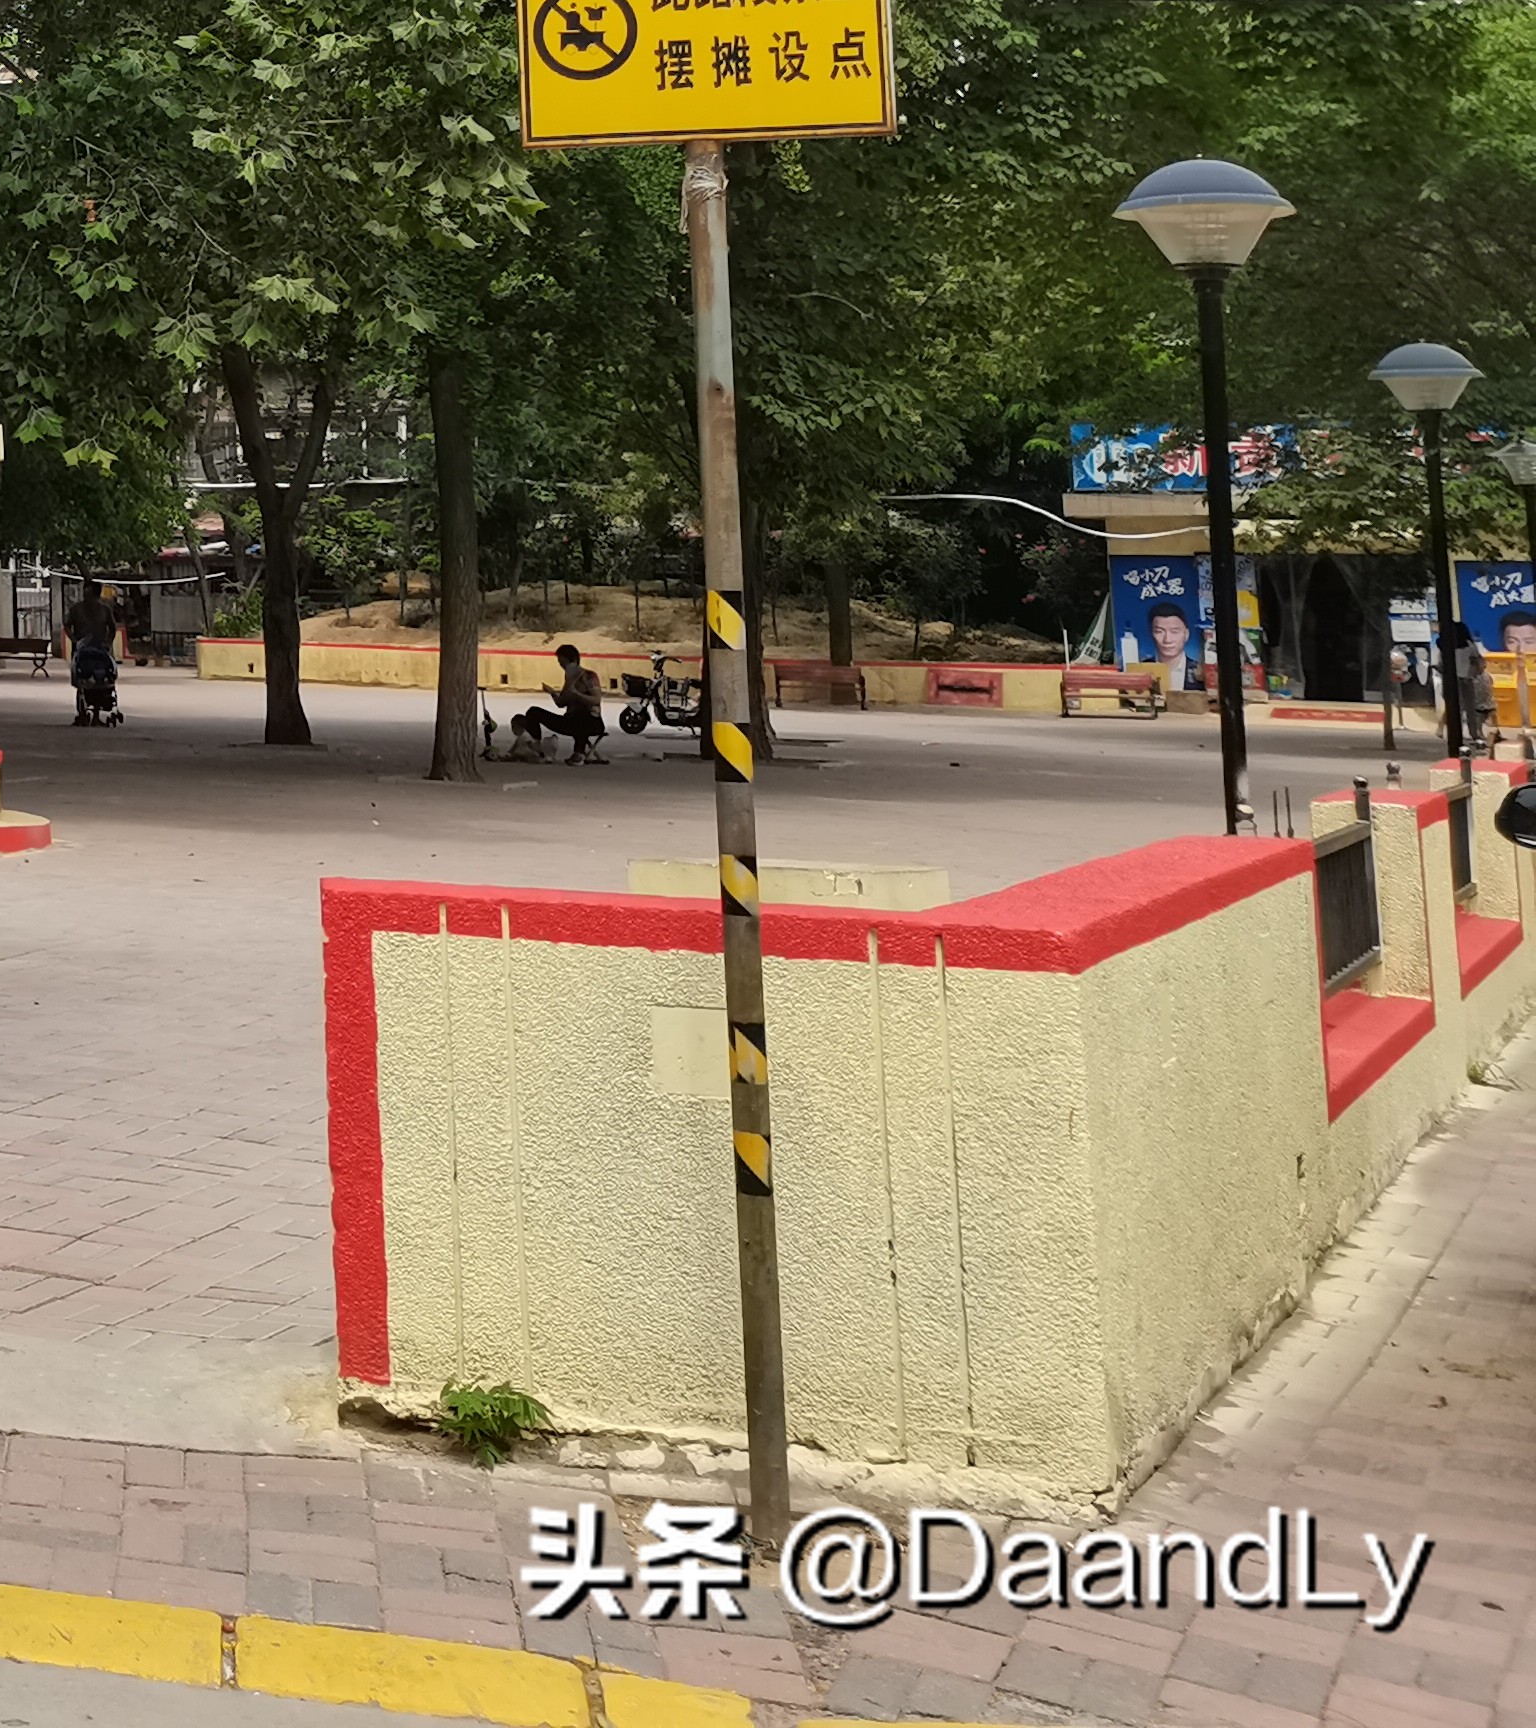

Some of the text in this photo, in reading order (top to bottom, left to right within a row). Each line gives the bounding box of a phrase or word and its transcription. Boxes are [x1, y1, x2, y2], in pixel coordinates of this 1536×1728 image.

[654, 26, 872, 92] 摆摊设点
[1123, 566, 1170, 585] 喝小刀
